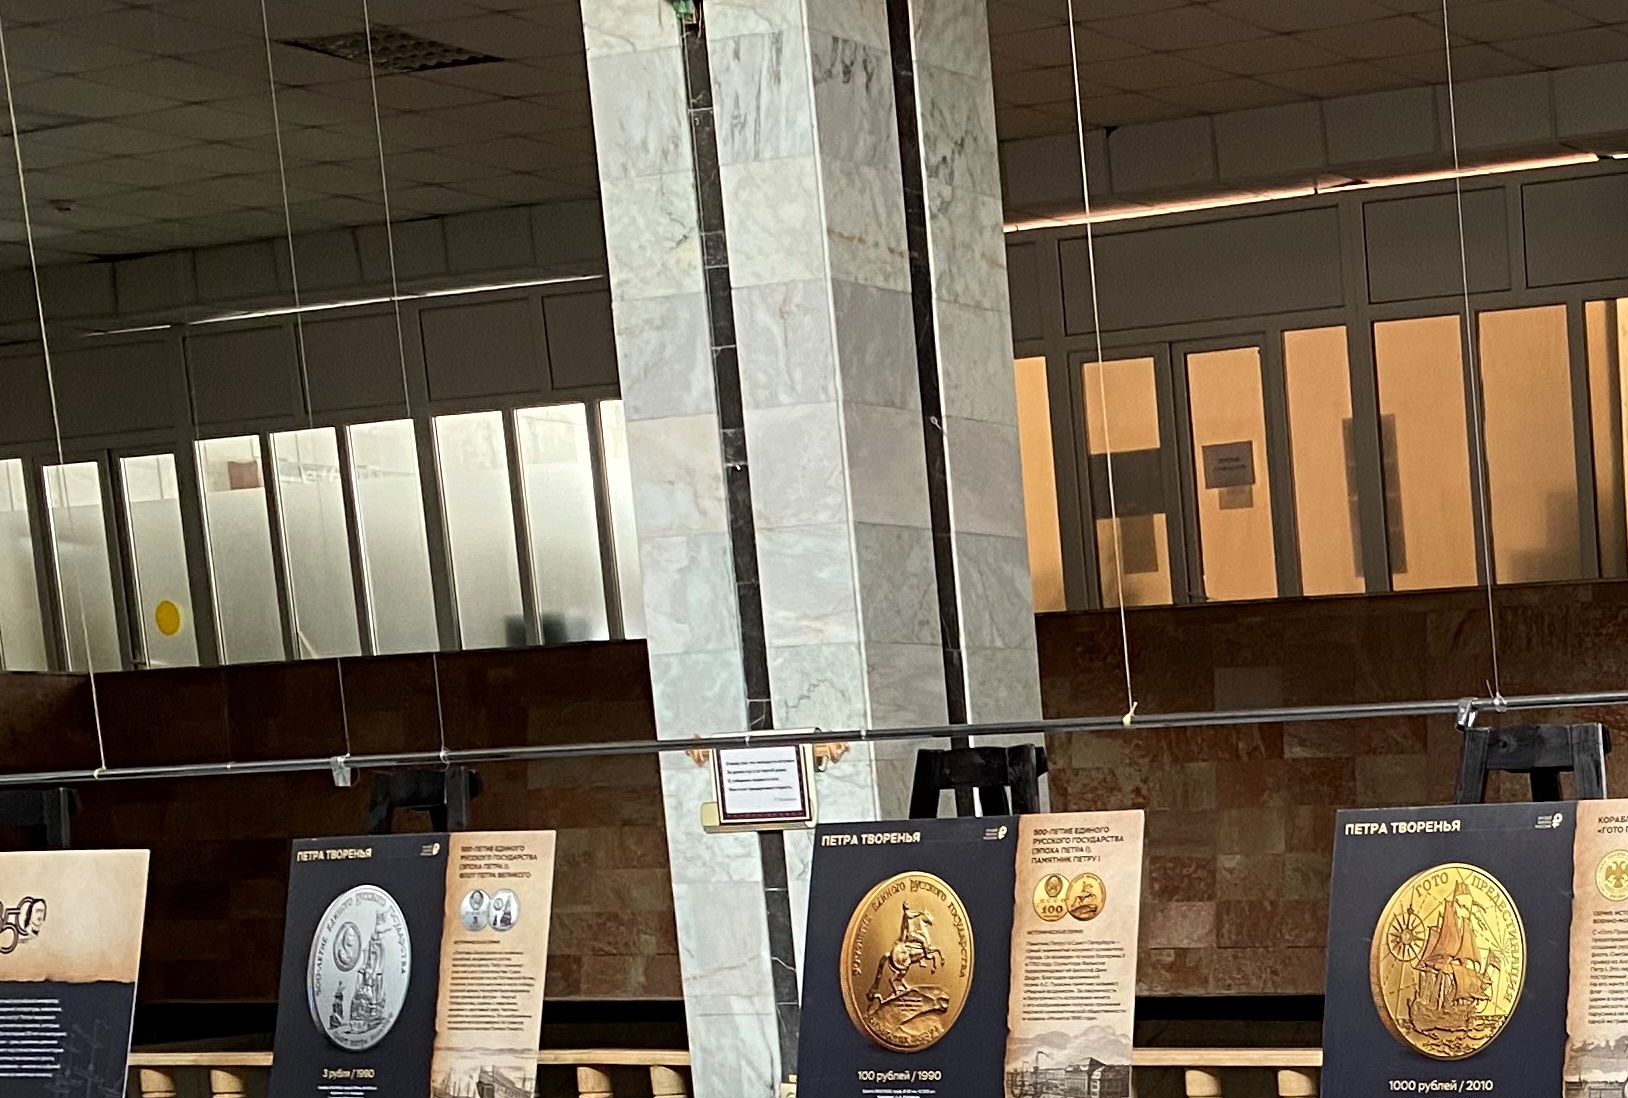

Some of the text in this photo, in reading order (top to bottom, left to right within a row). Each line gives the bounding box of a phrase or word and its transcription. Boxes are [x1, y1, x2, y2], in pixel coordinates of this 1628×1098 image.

[1345, 820, 1460, 835] ПЕТРА ТВОРЕНЬЯ
[822, 832, 921, 846] ПЕТРА ТВОРЕНЬЯ
[297, 848, 372, 862] ПЕТРА ТВОРЕНЬЯ
[1415, 872, 1449, 898] ГОТО
[1041, 905, 1063, 914] 100
[858, 1071, 875, 1080] 100
[876, 1071, 910, 1083] рублей
[918, 1071, 942, 1081] 1990
[1388, 1080, 1416, 1091] 1000
[1418, 1080, 1457, 1094] рублей
[1466, 1080, 1494, 1091] 2010
